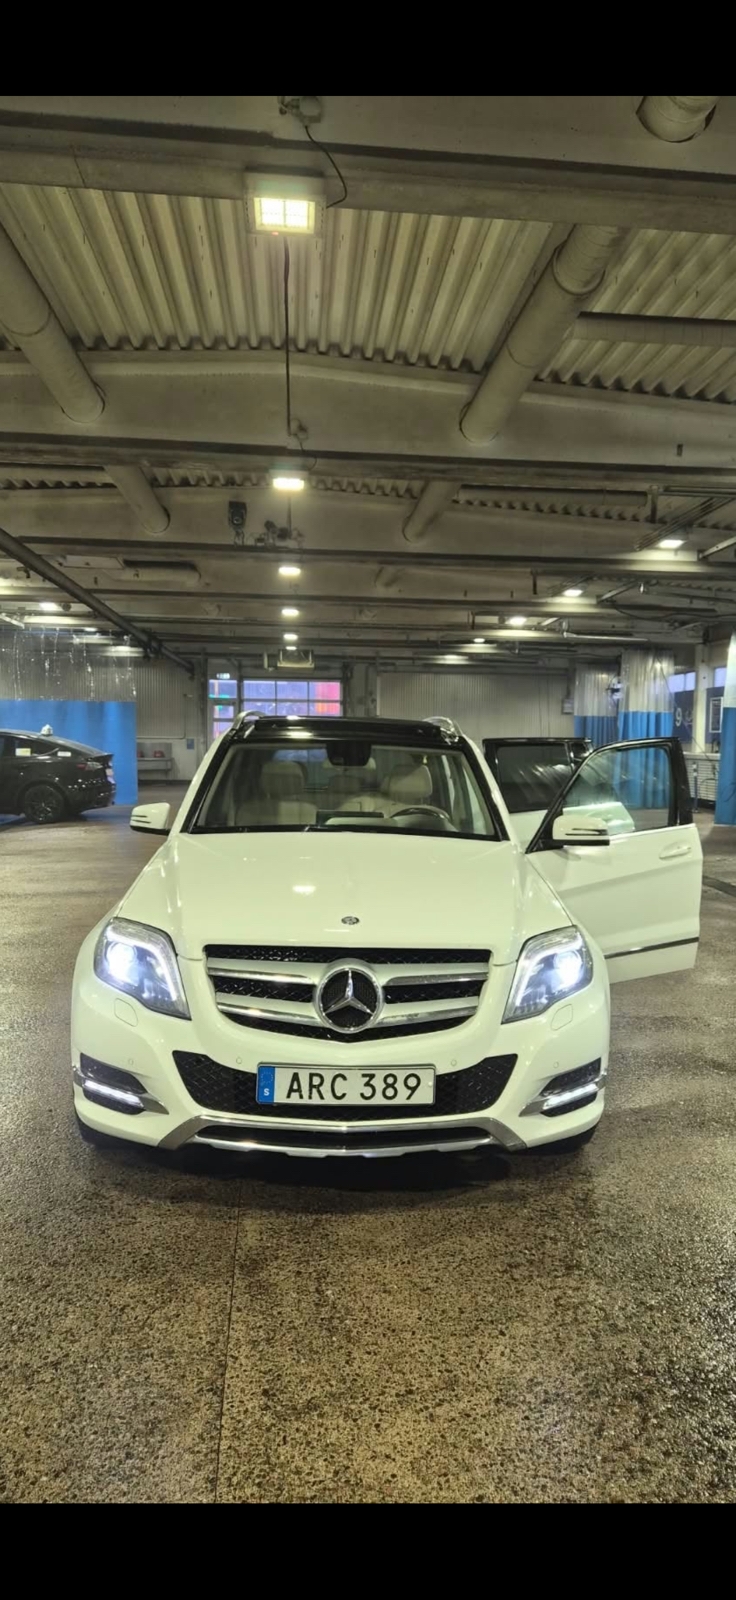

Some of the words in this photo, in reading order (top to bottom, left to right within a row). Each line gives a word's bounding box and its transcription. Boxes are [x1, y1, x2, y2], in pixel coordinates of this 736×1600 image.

[675, 707, 683, 727] 9
[263, 1087, 270, 1096] S
[286, 1072, 348, 1100] ARC
[359, 1072, 421, 1100] 389
